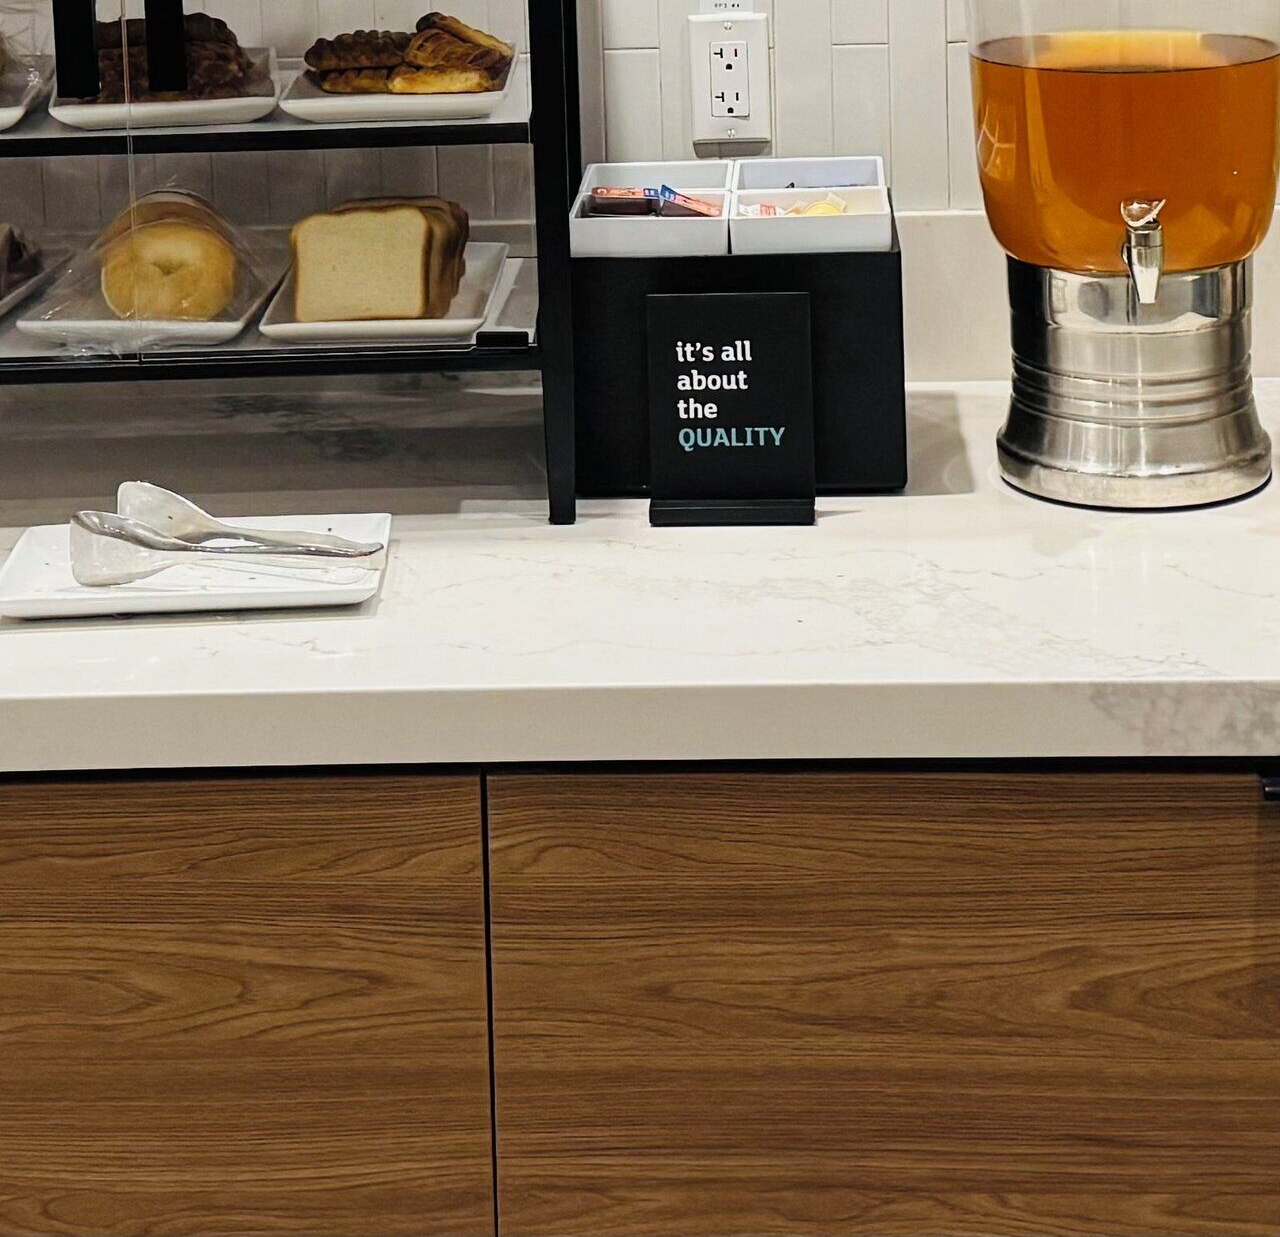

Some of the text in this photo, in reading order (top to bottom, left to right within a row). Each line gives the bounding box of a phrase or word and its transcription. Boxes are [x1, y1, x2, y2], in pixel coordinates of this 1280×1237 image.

[721, 341, 752, 361] all
[677, 370, 748, 390] about
[677, 398, 717, 418] the
[679, 427, 785, 451] QUALITY
